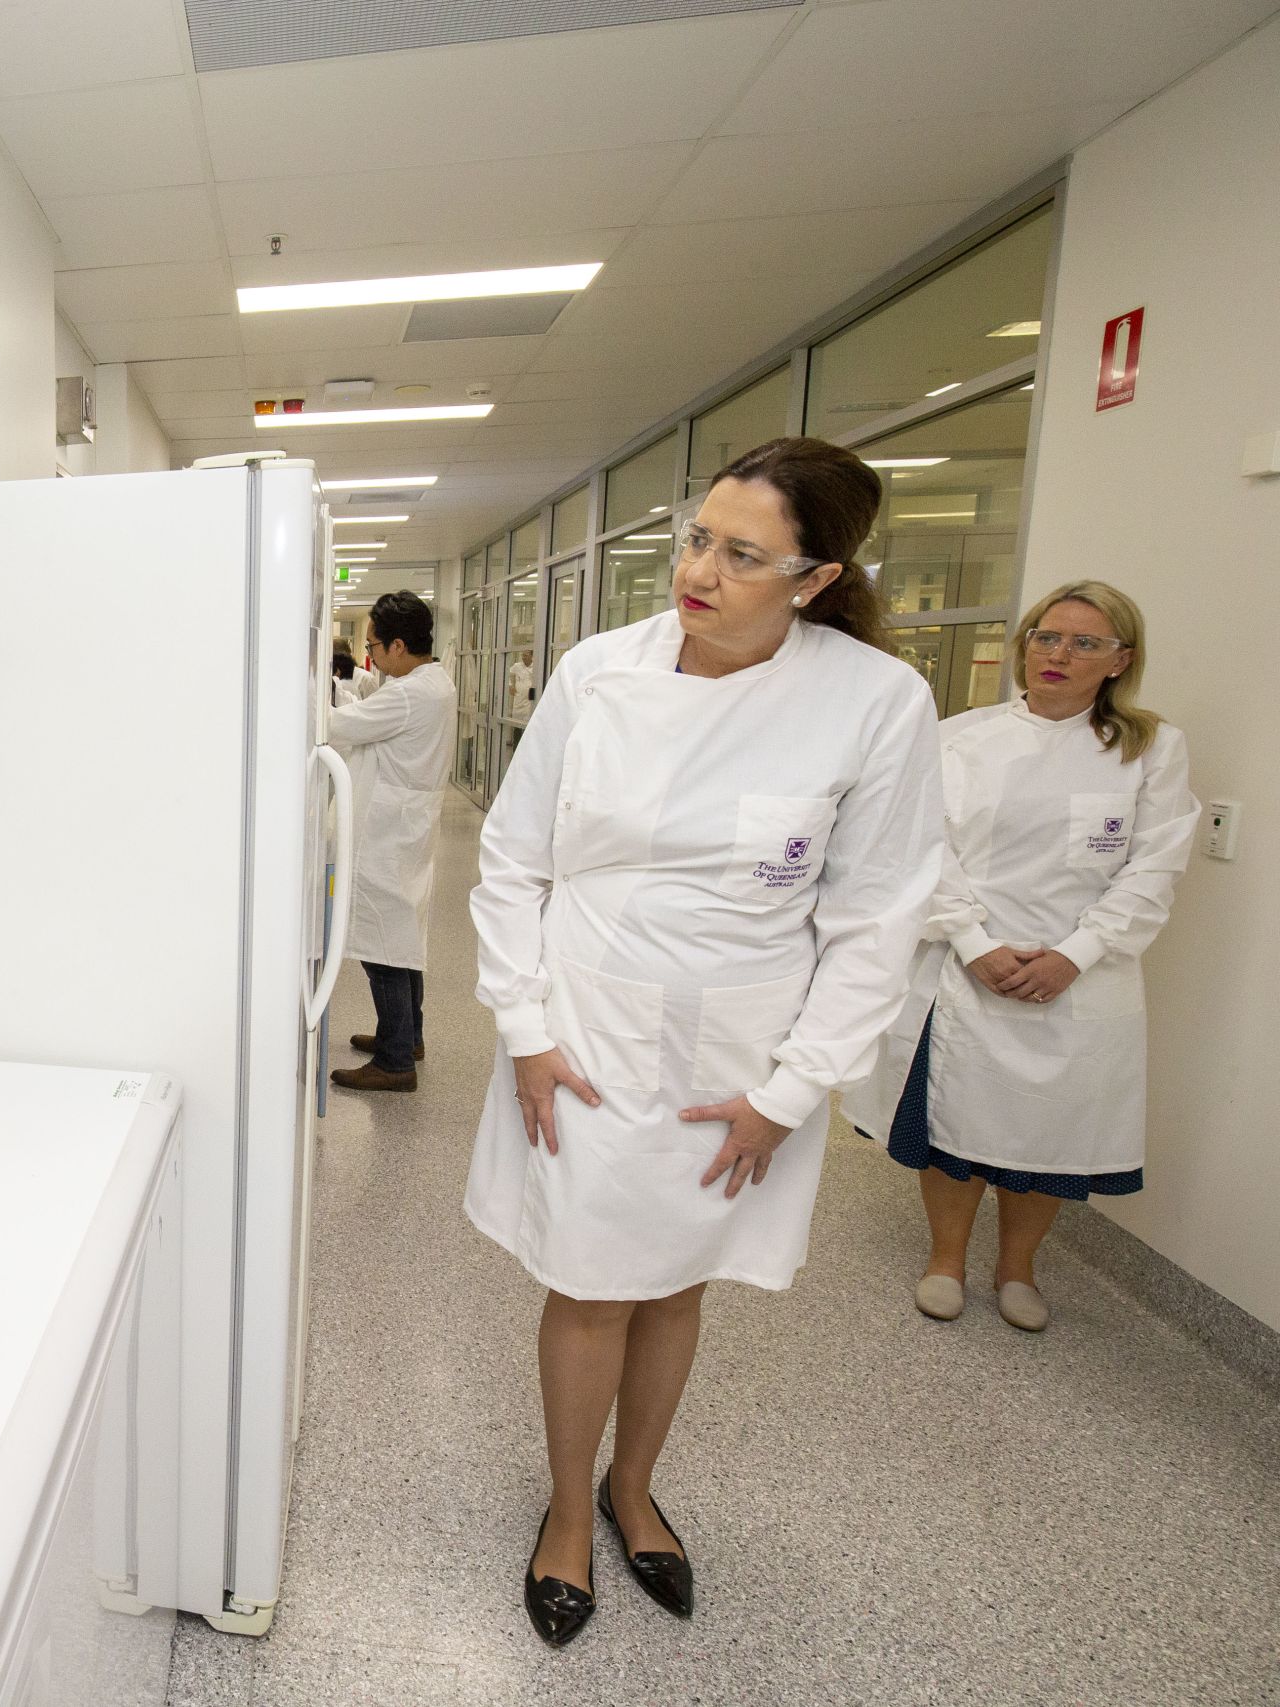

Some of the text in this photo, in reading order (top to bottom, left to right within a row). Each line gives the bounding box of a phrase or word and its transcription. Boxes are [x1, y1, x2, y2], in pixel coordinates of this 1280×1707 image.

[1110, 381, 1123, 392] FIRE
[758, 861, 777, 872] THE
[753, 870, 766, 878] OF
